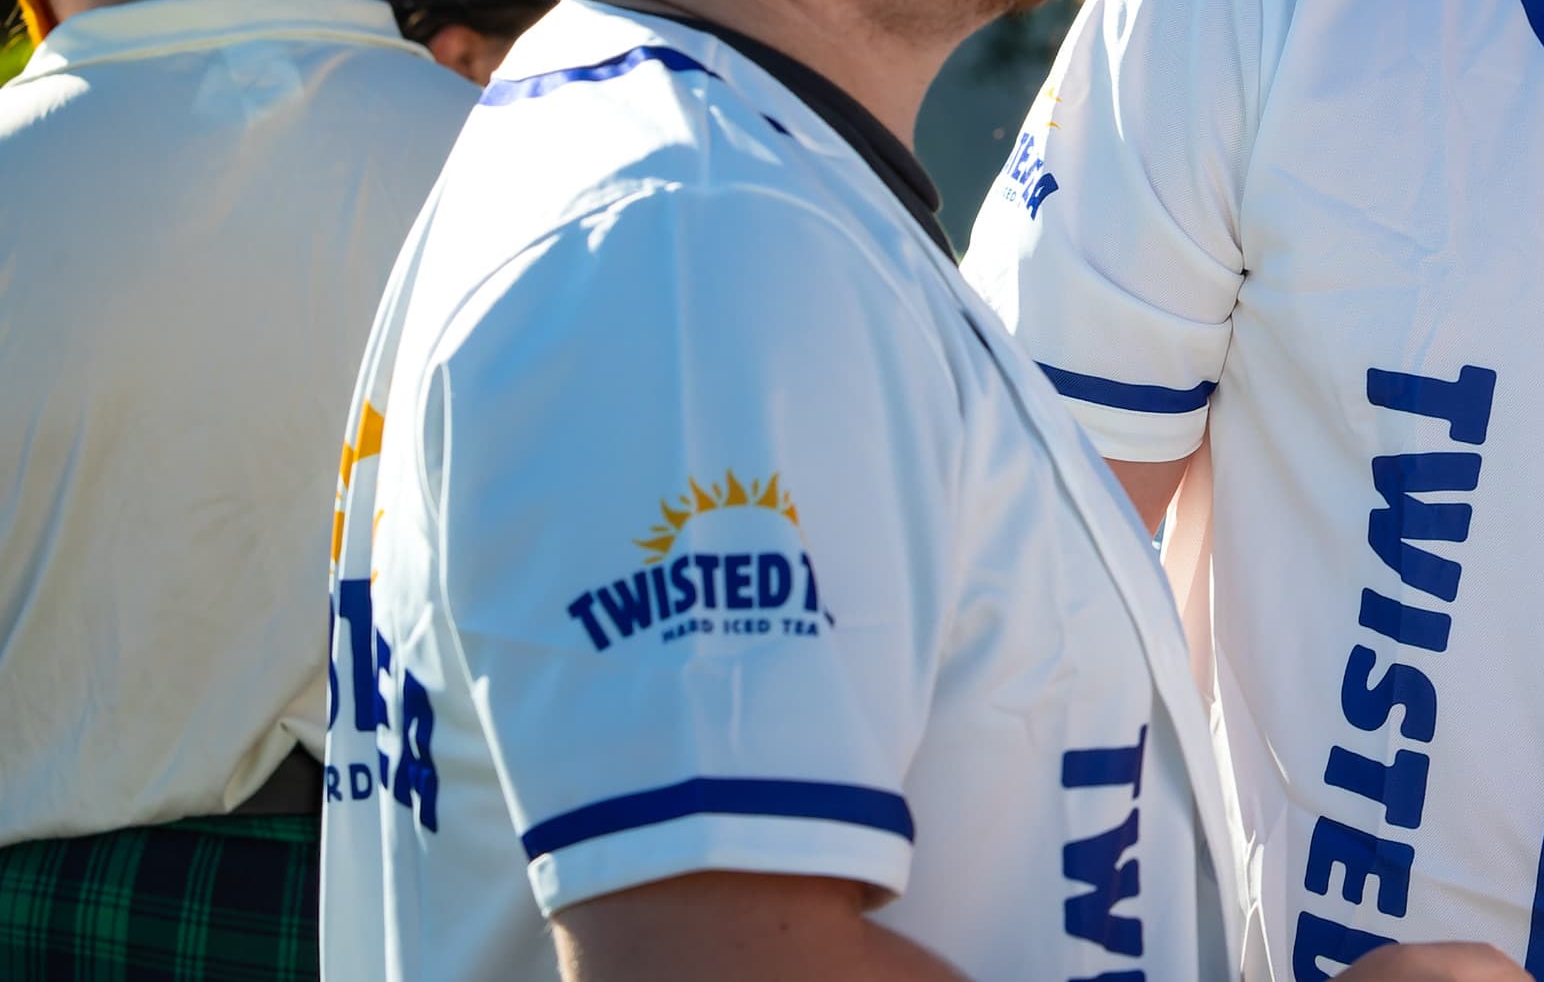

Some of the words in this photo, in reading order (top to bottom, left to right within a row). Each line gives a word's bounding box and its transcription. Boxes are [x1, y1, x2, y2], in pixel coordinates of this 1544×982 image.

[566, 551, 793, 653] TWISTED
[723, 618, 771, 636] ICED
[783, 619, 820, 637] TEA
